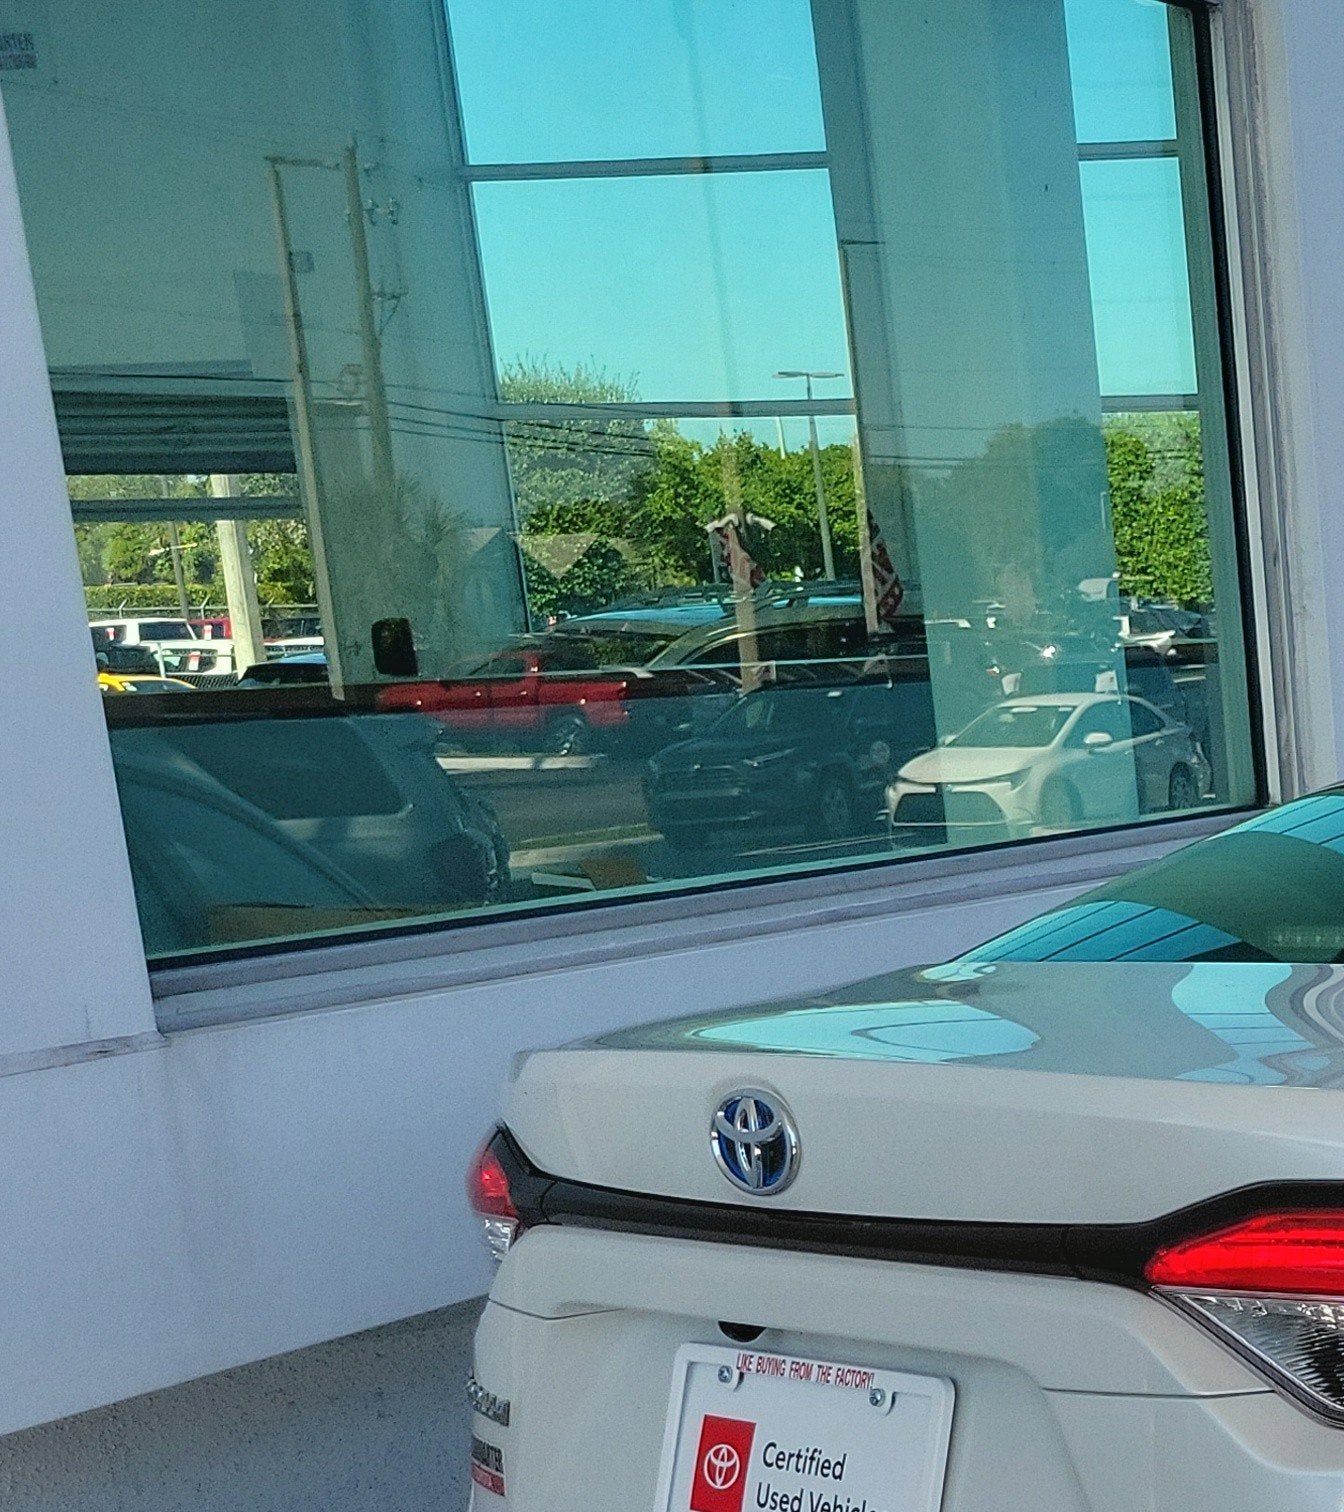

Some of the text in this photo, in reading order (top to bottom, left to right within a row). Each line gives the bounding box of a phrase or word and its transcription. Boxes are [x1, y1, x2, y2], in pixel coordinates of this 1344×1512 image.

[736, 1353, 876, 1390] LIKE BUYING FROM THE FACTORY!
[762, 1442, 847, 1481] Certified
